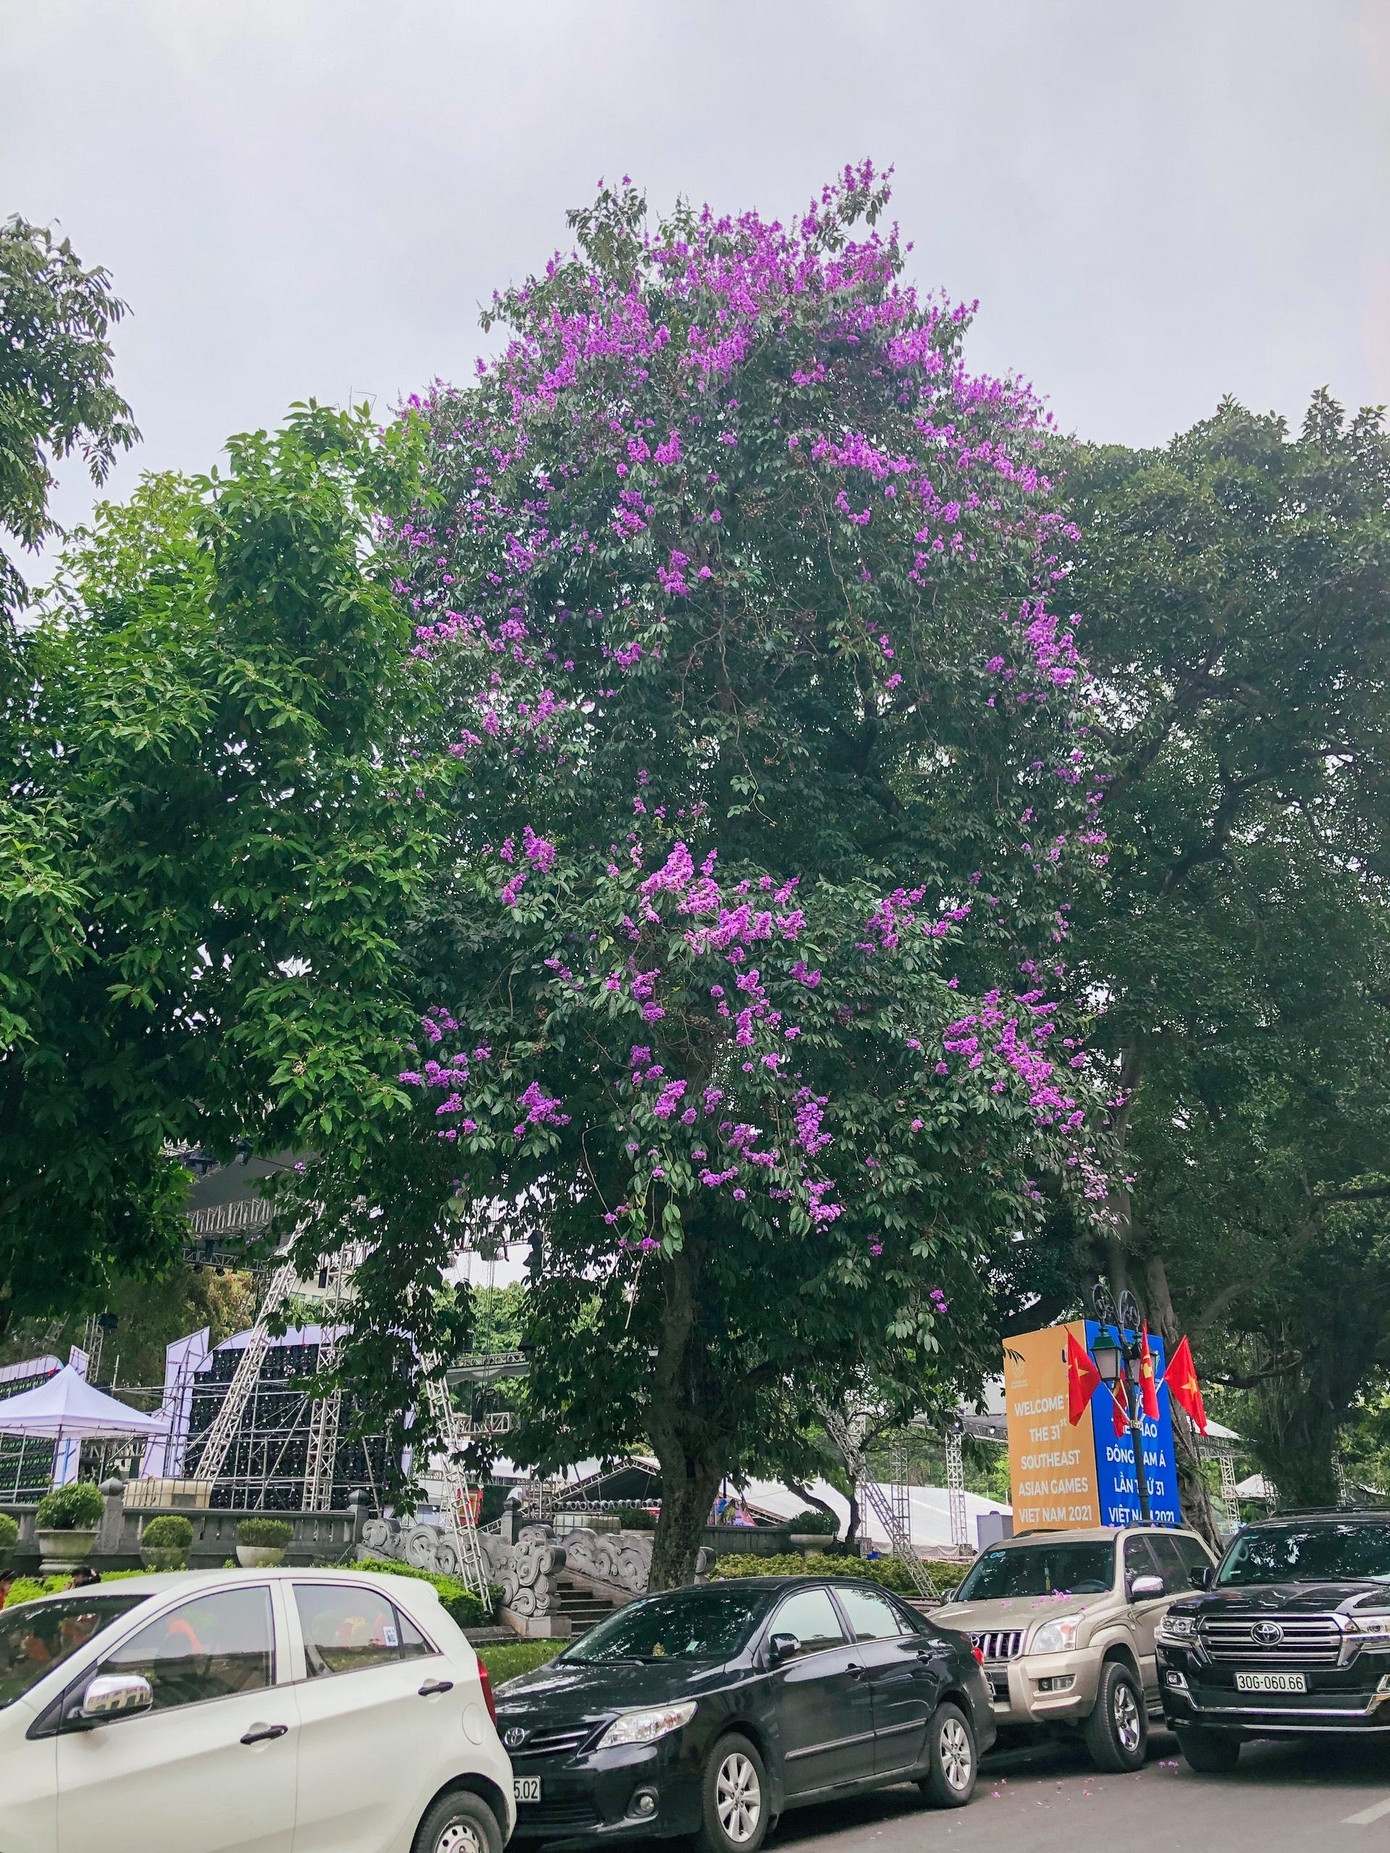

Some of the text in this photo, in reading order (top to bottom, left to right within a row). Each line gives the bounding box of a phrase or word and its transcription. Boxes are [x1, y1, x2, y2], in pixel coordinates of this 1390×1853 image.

[1014, 1394, 1065, 1417] WELCOME
[1029, 1426, 1049, 1443] THE
[1021, 1449, 1081, 1470] SOUTHEAST
[1106, 1443, 1135, 1465] ĐÔNG
[1159, 1449, 1167, 1468] Á
[1018, 1476, 1089, 1497] ASIAN GAMES
[1113, 1471, 1165, 1496] LẦN TỨ 31
[1018, 1504, 1093, 1523] VIET NAM 2021
[1238, 1675, 1304, 1690] 30G-060.66
